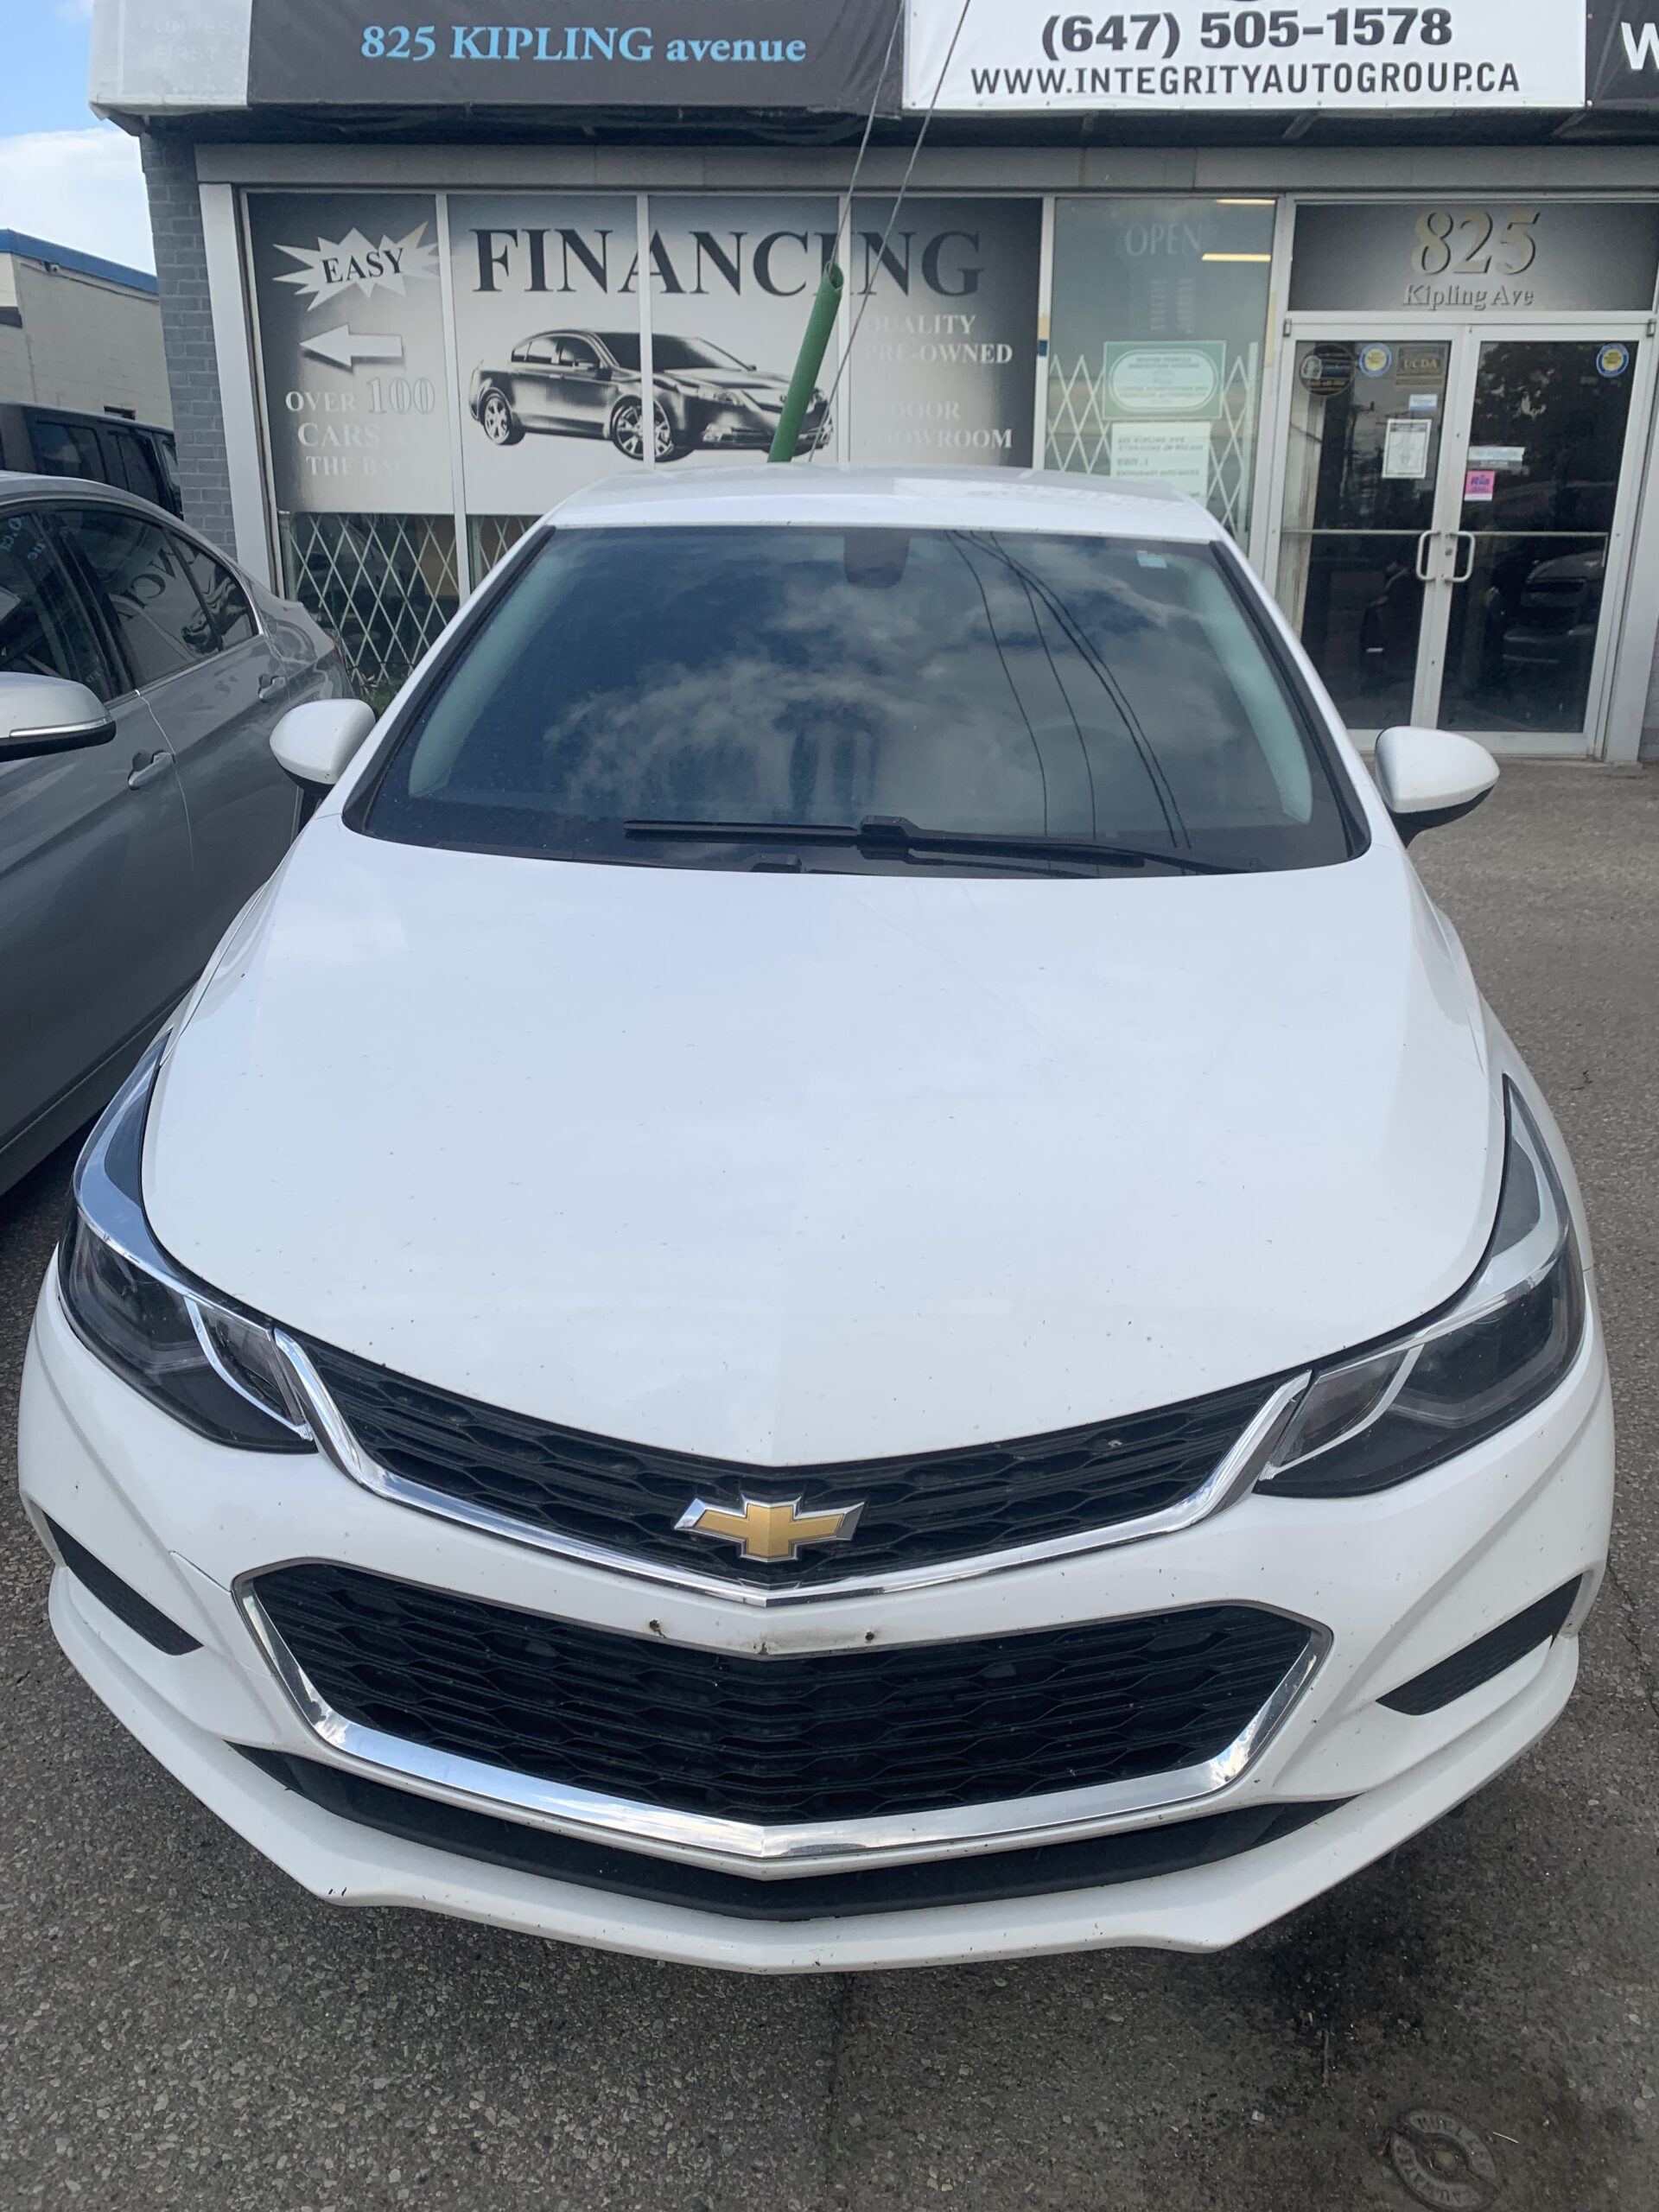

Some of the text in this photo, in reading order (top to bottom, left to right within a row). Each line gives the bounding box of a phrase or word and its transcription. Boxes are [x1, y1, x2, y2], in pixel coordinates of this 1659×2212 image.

[361, 25, 807, 62] 825 KIPLING avenue
[1041, 7, 1452, 60] (647) 505-1578
[970, 61, 1521, 95] WWW.INTEGRITYAUTOGROUP.CA
[1125, 223, 1203, 257] OPEN
[1412, 210, 1541, 275] 825
[321, 248, 405, 284] EASY
[1402, 284, 1535, 311] Kipling Ave
[867, 314, 976, 335] QUALITY
[865, 343, 1014, 364] PRE-OWNED
[285, 376, 435, 415] OVER 100
[297, 422, 380, 448] CARS
[305, 454, 357, 476] THE
